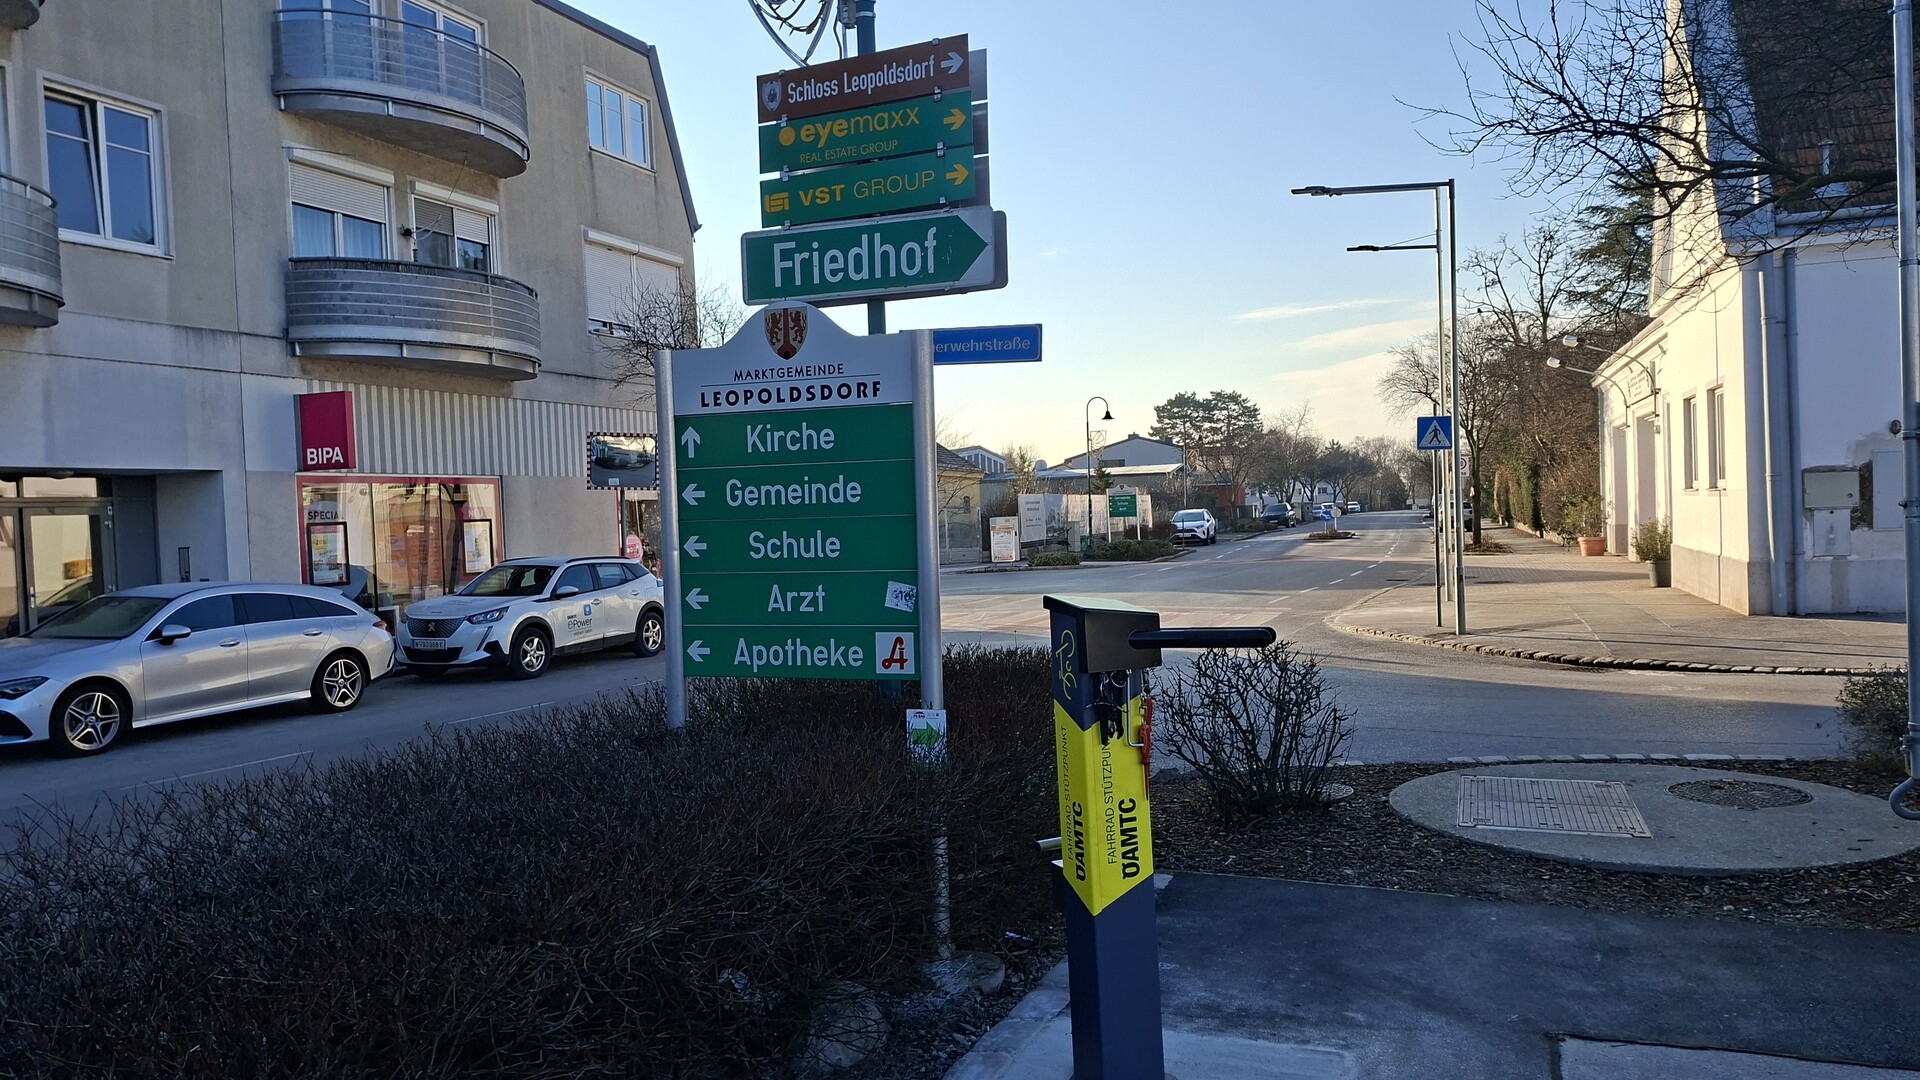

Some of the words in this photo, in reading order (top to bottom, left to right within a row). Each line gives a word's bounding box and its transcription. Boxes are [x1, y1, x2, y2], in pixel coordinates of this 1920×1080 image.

[788, 79, 838, 104] Schloss
[844, 55, 935, 95] Leopoldsdorf
[801, 107, 920, 147] eyemaxx
[800, 151, 822, 164] REAL
[825, 146, 859, 161] ESTATE
[860, 140, 898, 156] GROUP
[799, 184, 845, 207] VST
[853, 170, 935, 199] GROUP
[773, 226, 937, 288] Friedhof
[933, 337, 1031, 353] erwehrstraße
[734, 363, 845, 382] MARKTGEMEINDE
[701, 381, 881, 408] LEOPOLDSDORF
[746, 422, 835, 453] Kirche
[306, 447, 344, 465] BIPA
[726, 475, 862, 507] Gemeinde
[308, 511, 343, 520] SPECIA
[749, 530, 841, 559] Schule
[768, 584, 826, 612] Arzt
[568, 618, 592, 630] ePower
[734, 638, 864, 673] Apotheke
[1061, 726, 1071, 802] STÜTZPUNKT
[1101, 742, 1114, 806] STÜTZPUN
[1065, 805, 1074, 861] FAHRRAD
[1073, 801, 1087, 882] ÖAMTC
[1106, 808, 1117, 865] FAHRRAD
[1118, 798, 1141, 880] ÖAMTC
